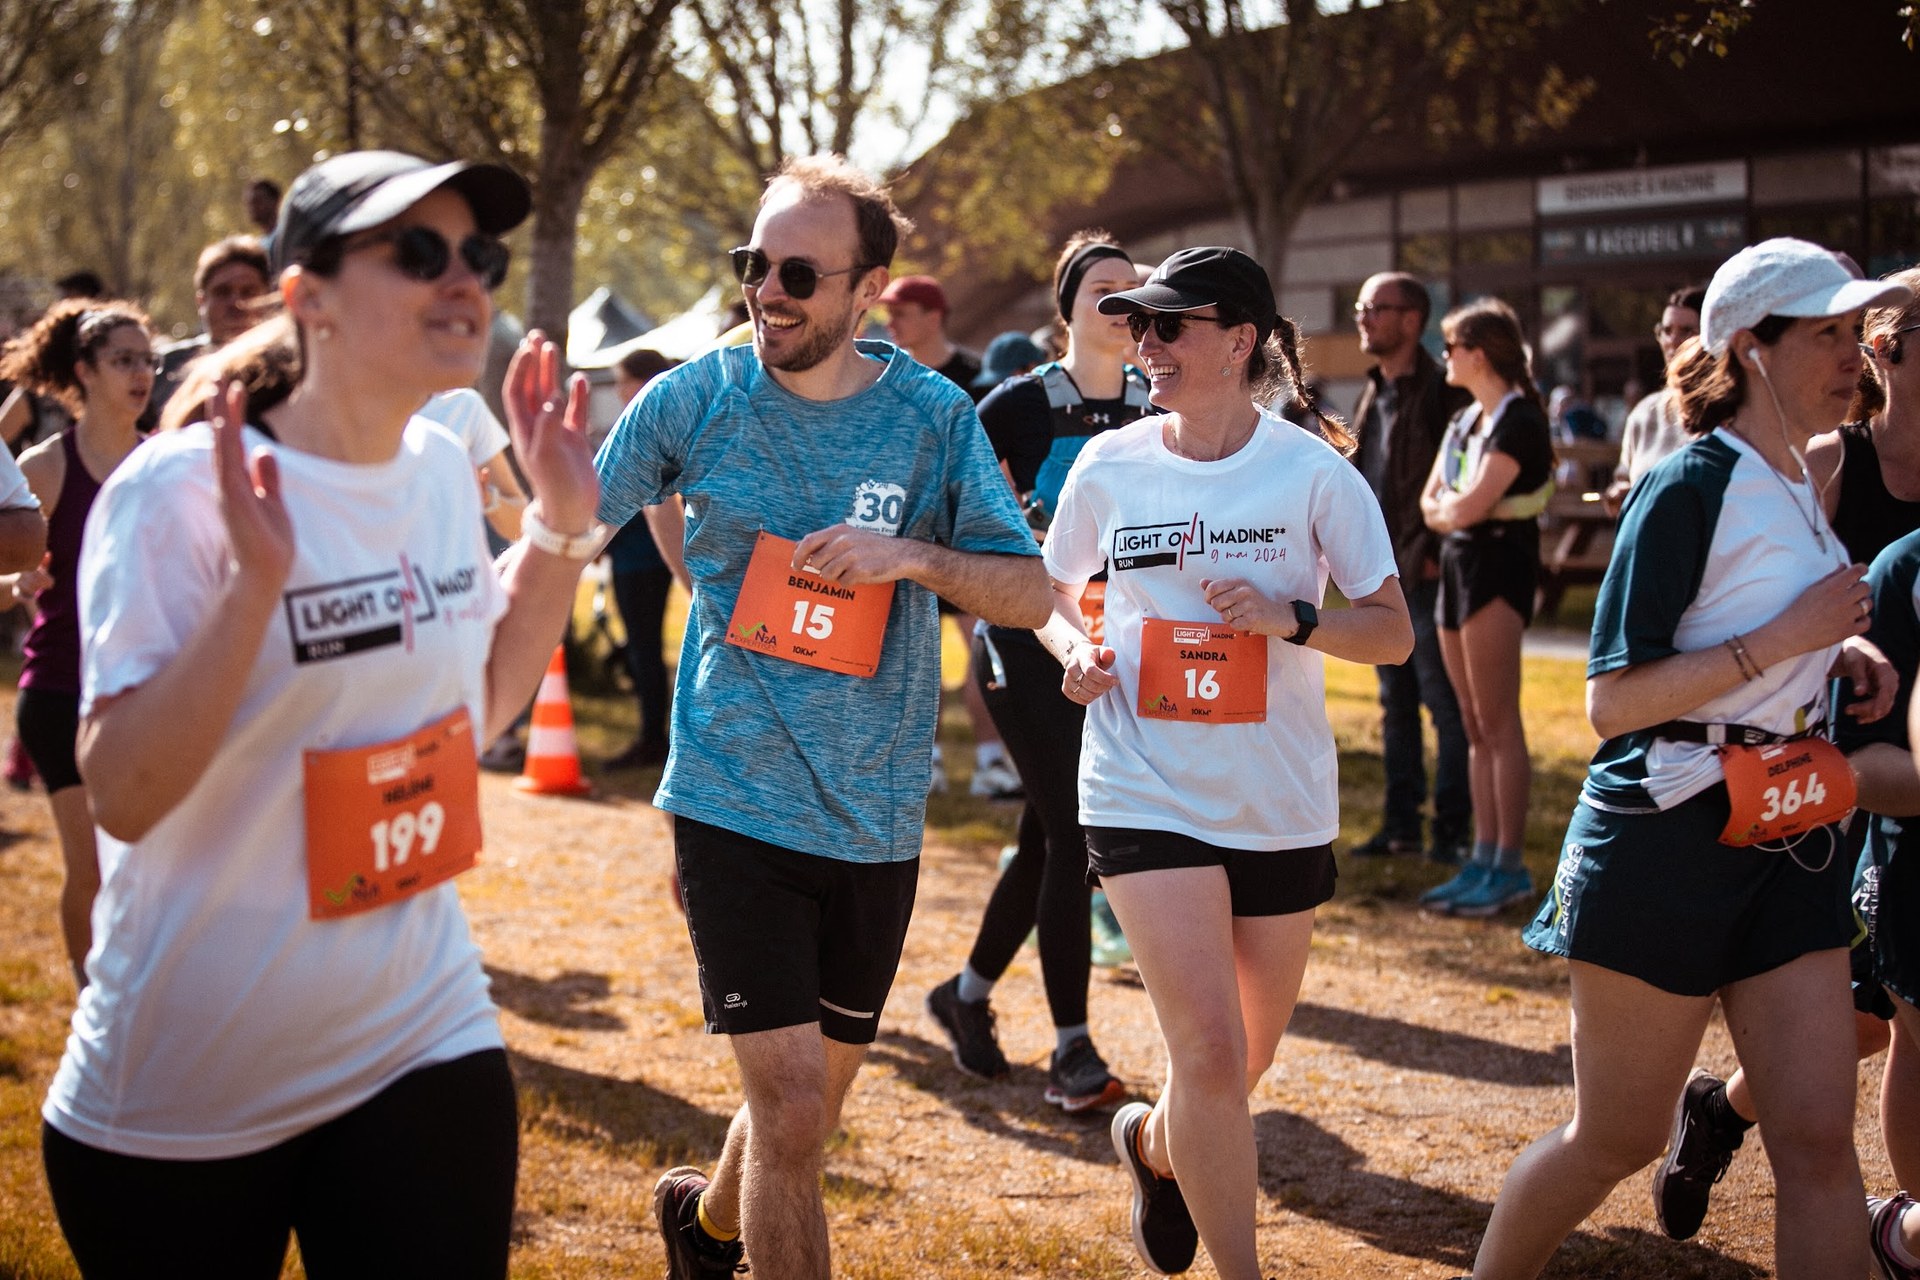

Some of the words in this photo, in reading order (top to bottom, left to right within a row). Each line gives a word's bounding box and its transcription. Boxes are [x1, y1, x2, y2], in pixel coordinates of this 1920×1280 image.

[859, 492, 904, 525] 30
[1118, 533, 1162, 551] LIGHT
[1118, 559, 1134, 568] RUN
[1210, 549, 1219, 564] 9
[1254, 547, 1287, 563] 2024
[787, 575, 856, 601] BENJAMIN
[302, 590, 378, 631] LIGHT
[791, 600, 835, 640] 15
[755, 630, 777, 646] N2A
[1176, 630, 1195, 638] LIGHT
[1180, 650, 1228, 662] SANDRA
[1185, 668, 1220, 700] 16
[1160, 702, 1178, 712] N2A
[1767, 752, 1813, 778] DELPHINE
[1760, 772, 1827, 821] 364
[370, 801, 445, 873] 199
